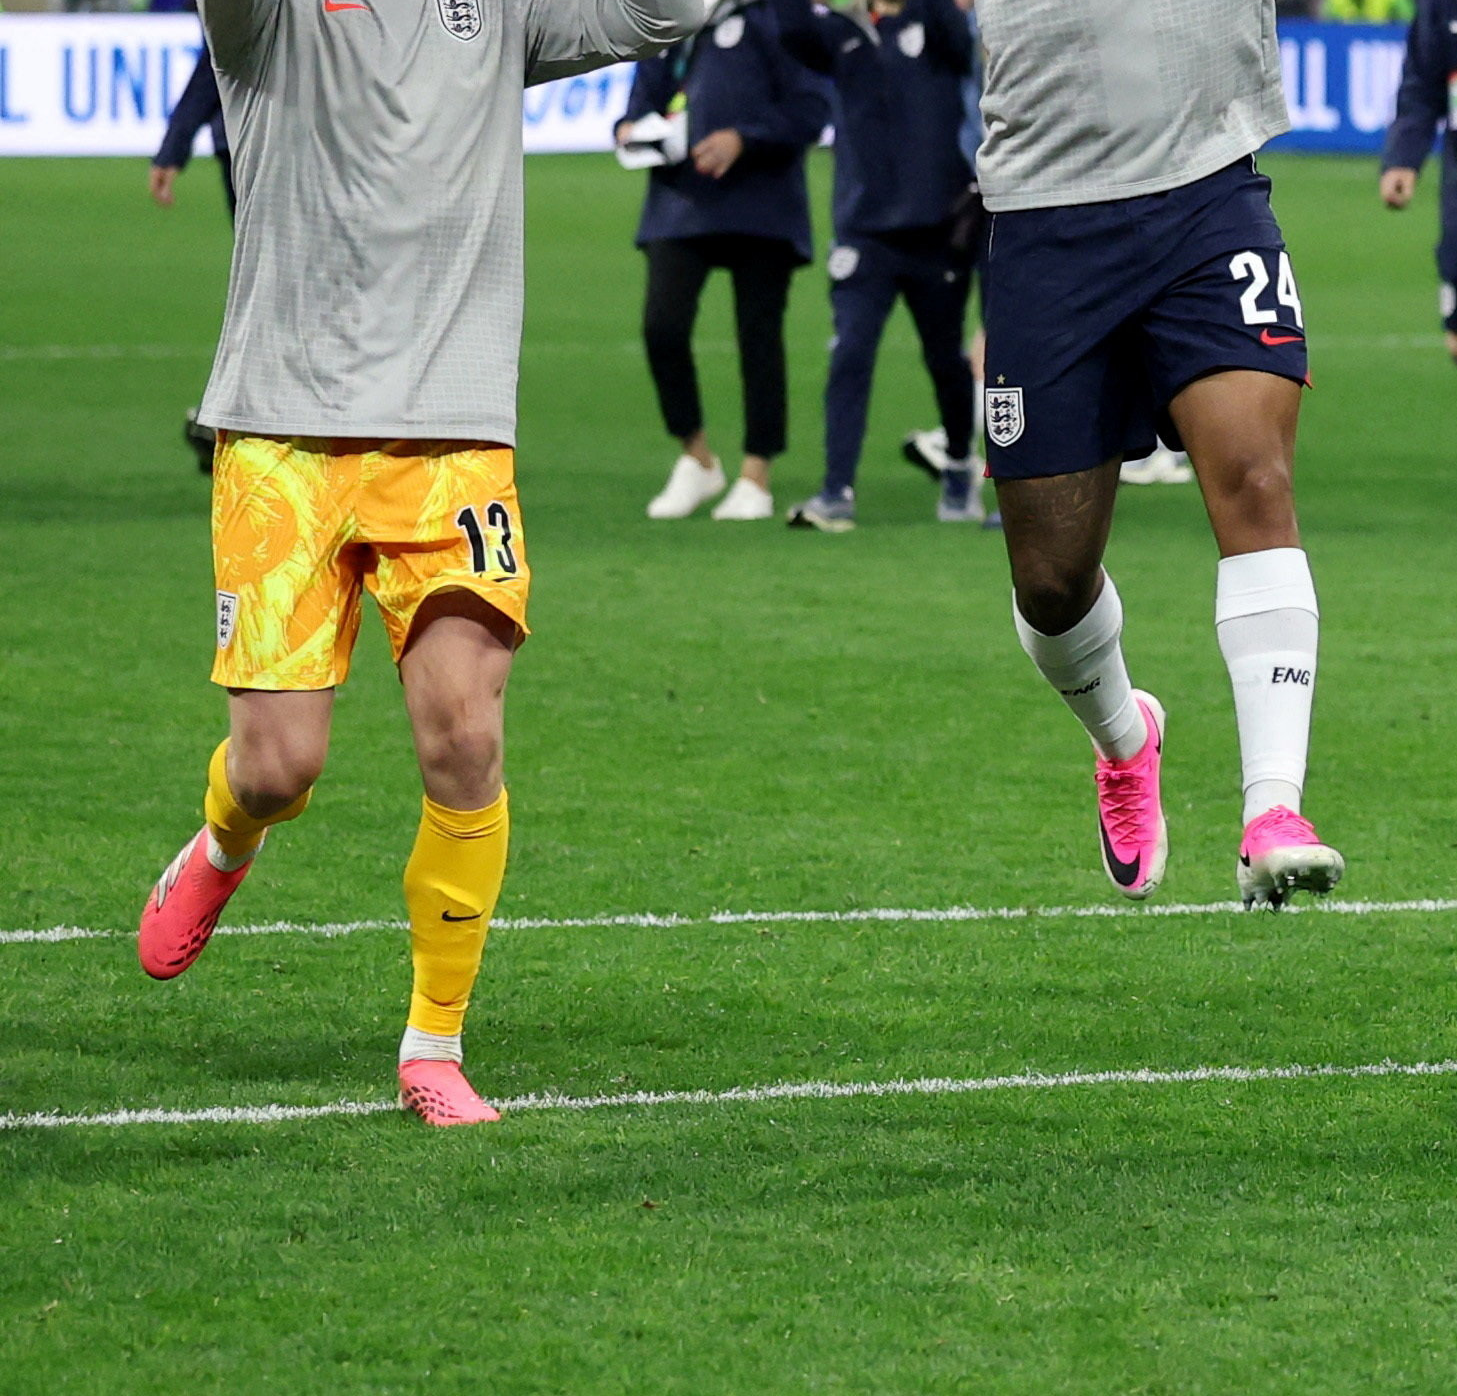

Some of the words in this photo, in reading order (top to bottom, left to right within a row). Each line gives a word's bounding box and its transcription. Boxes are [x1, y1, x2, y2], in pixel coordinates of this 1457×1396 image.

[1228, 250, 1304, 330] 24
[456, 500, 519, 576] 13
[1271, 666, 1311, 686] ENG
